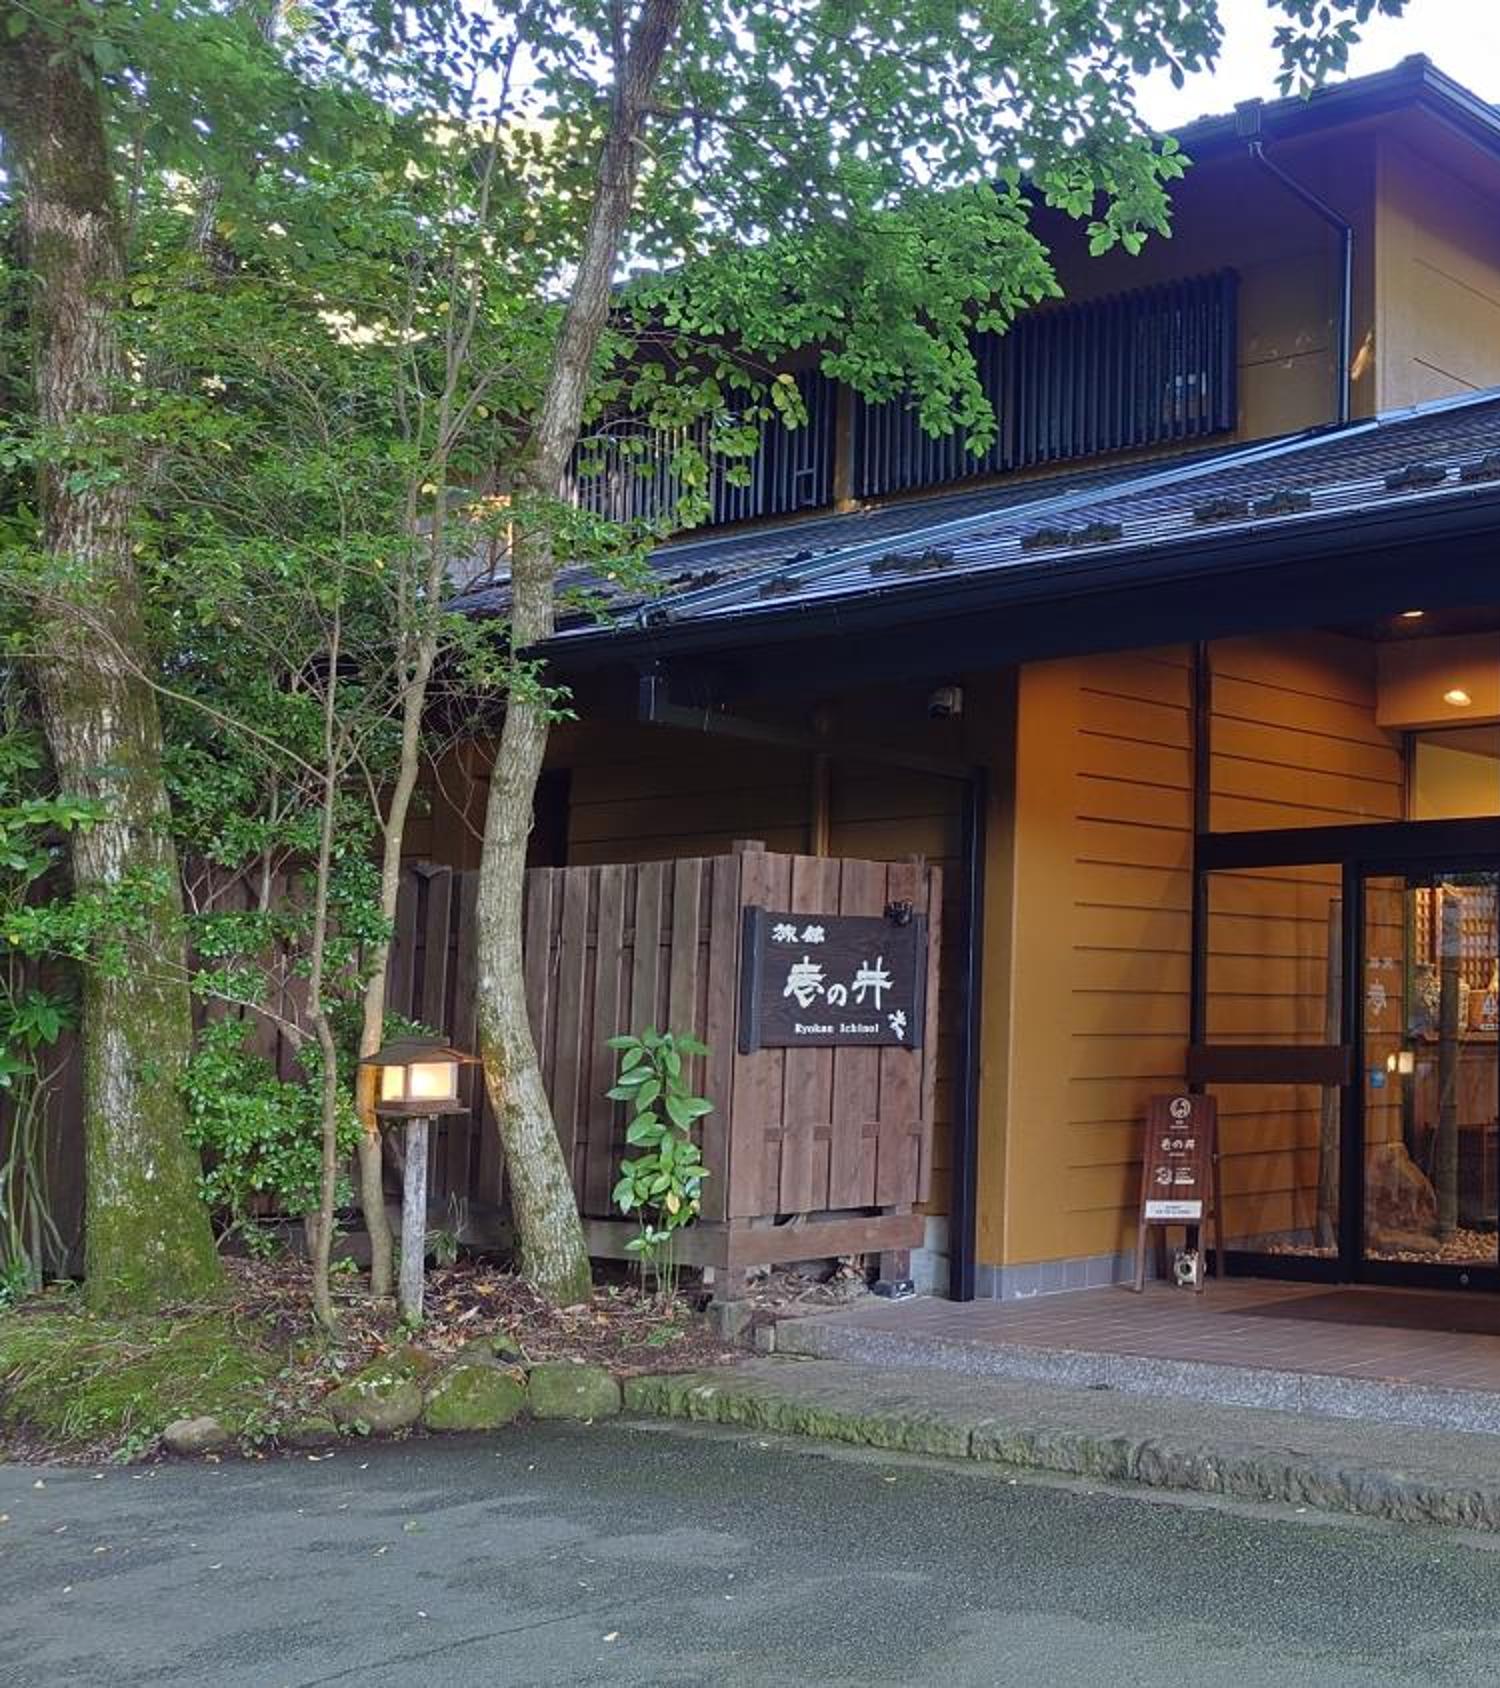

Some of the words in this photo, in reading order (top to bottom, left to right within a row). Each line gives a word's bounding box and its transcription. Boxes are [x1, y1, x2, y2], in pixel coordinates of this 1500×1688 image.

[783, 955, 895, 1010] 壱の井
[795, 1023, 834, 1034] Ryokan
